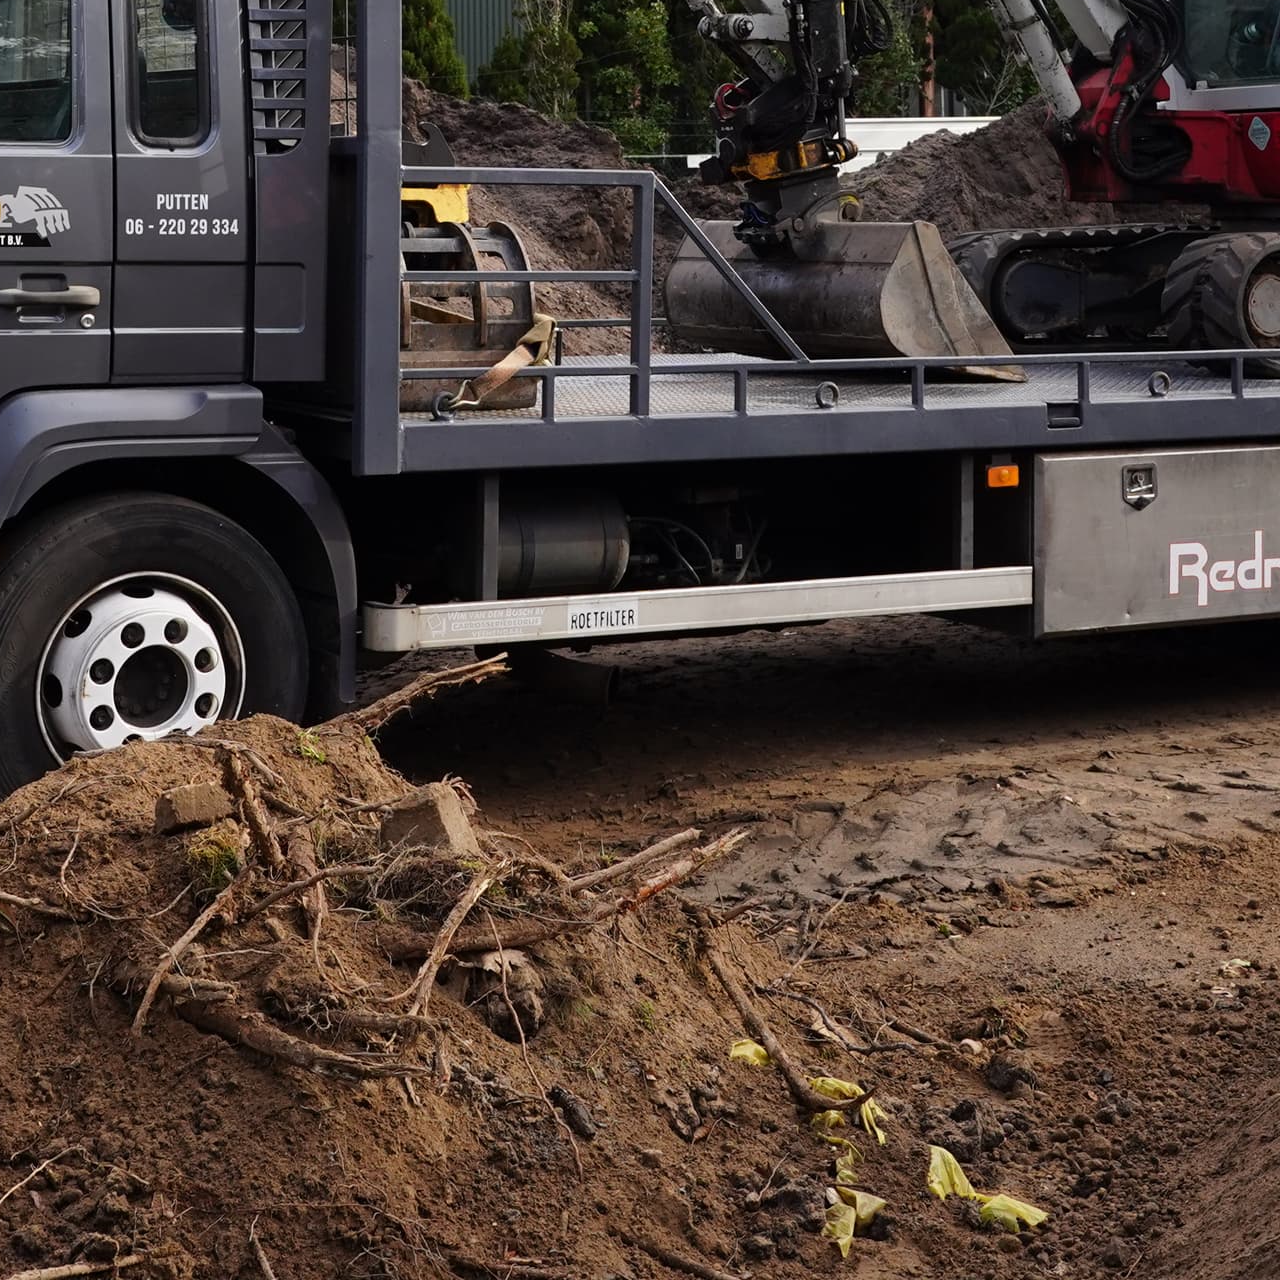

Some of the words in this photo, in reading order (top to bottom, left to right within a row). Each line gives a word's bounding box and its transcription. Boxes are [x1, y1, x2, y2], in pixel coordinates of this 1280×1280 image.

[156, 193, 209, 211] PUTTEN
[125, 218, 144, 235] 06
[159, 218, 186, 235] 220
[189, 218, 208, 235] 29
[212, 217, 239, 235] 334
[7, 234, 24, 246] B.V.
[571, 608, 635, 630] ROETFILTER
